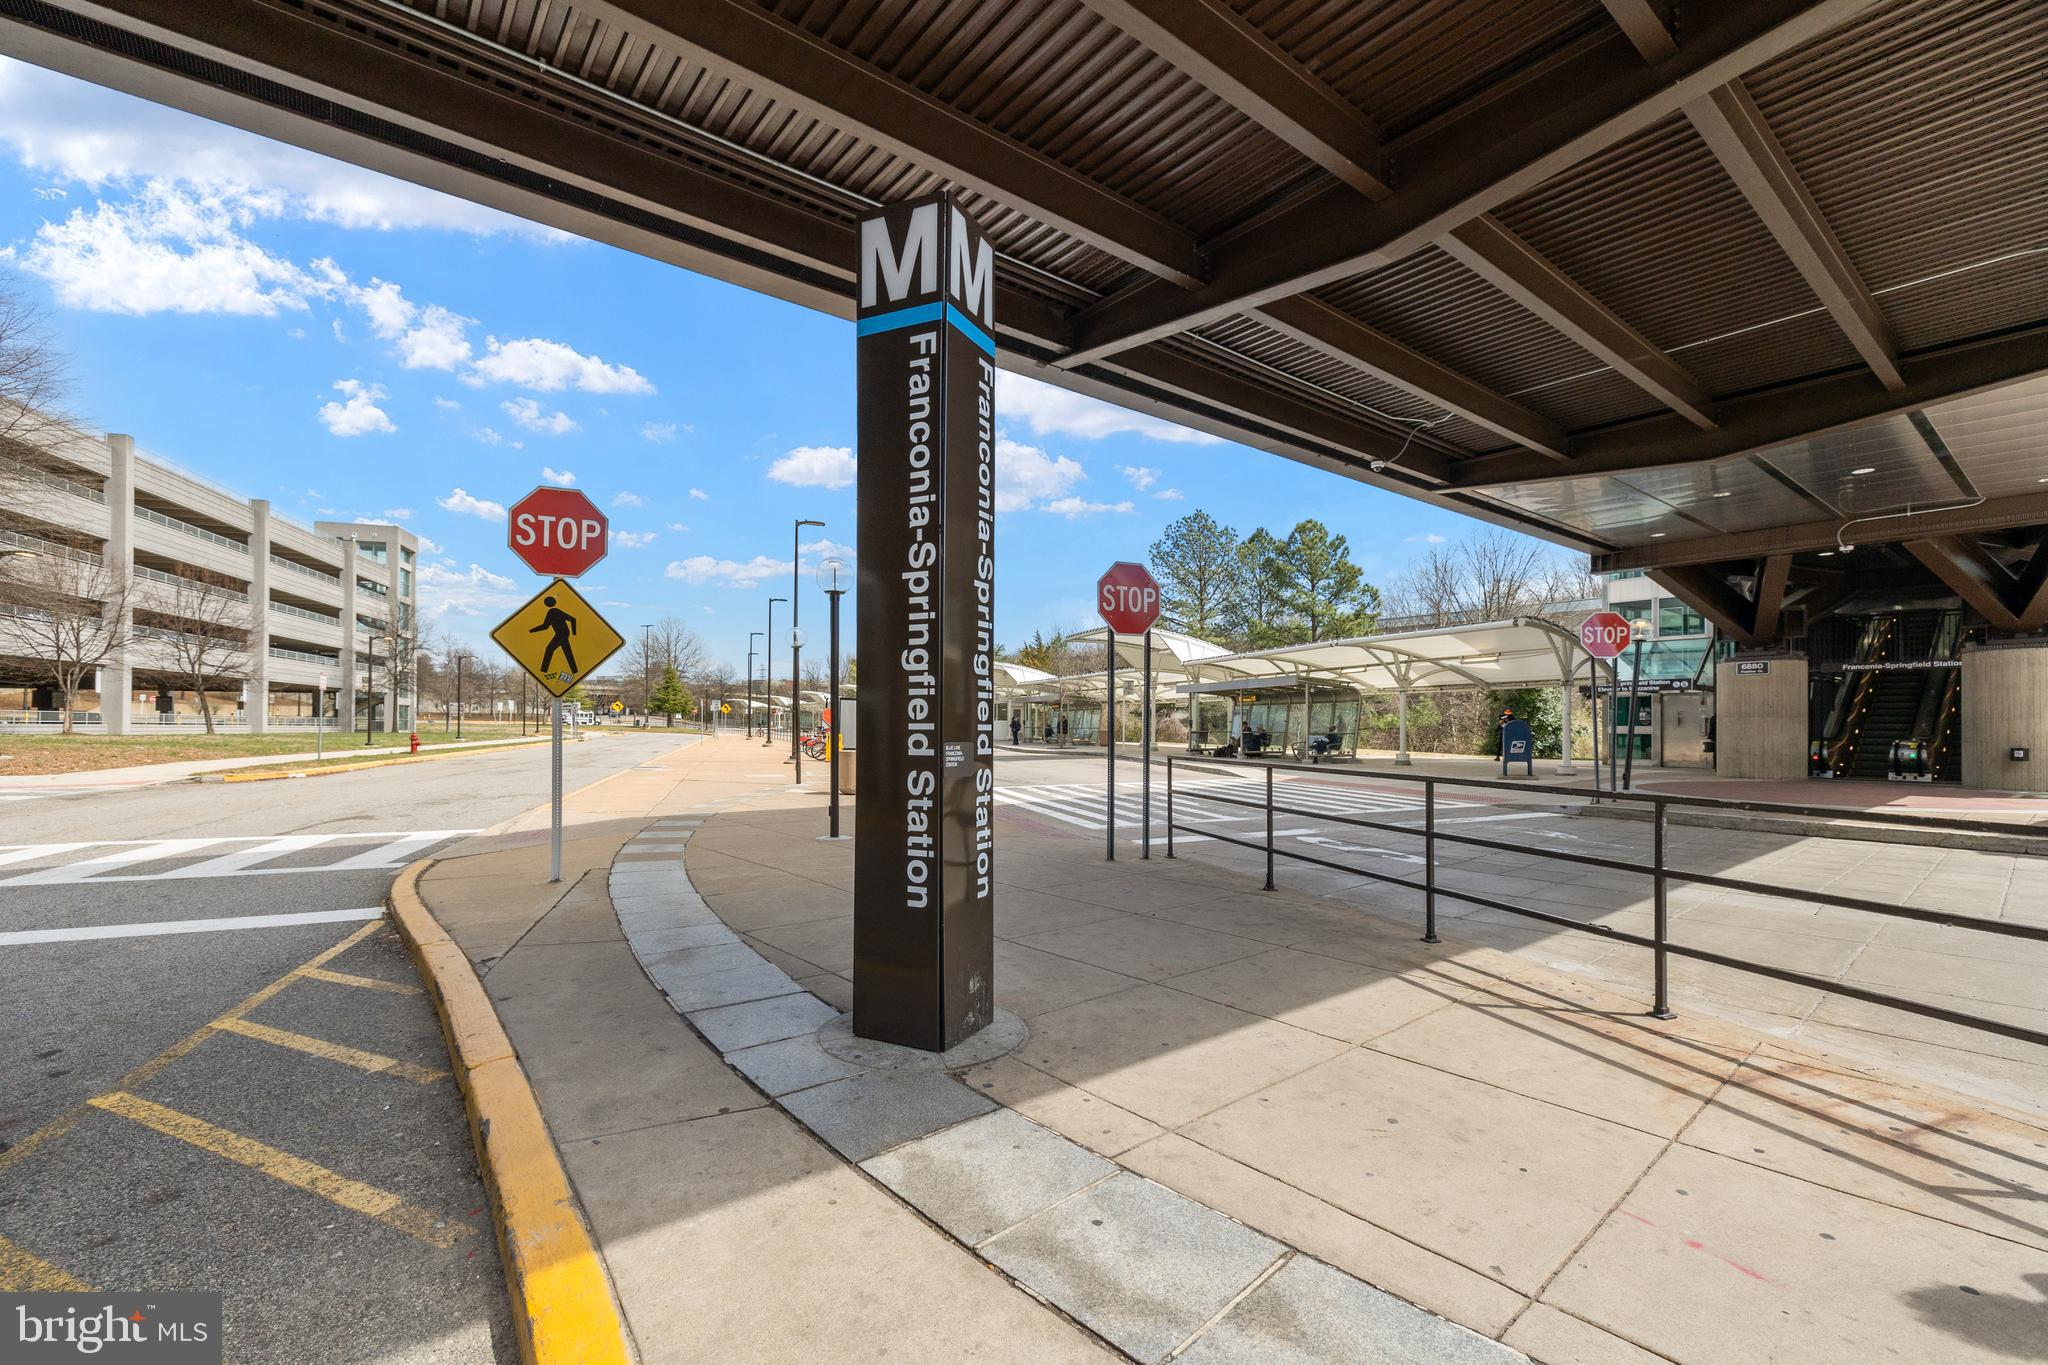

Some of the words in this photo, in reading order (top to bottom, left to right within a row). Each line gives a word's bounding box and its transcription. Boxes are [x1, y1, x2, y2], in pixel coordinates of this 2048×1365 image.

[861, 202, 938, 309] M
[950, 204, 994, 331] M
[515, 513, 601, 550] STOP
[901, 331, 937, 756] Franconia-Springfield
[973, 356, 994, 756] Franconia-Springfield
[1102, 584, 1157, 613] STOP
[1584, 626, 1628, 644] STOP
[1842, 661, 1931, 670] Franconia-Springfield
[907, 769, 935, 909] Station
[976, 768, 992, 899] Station
